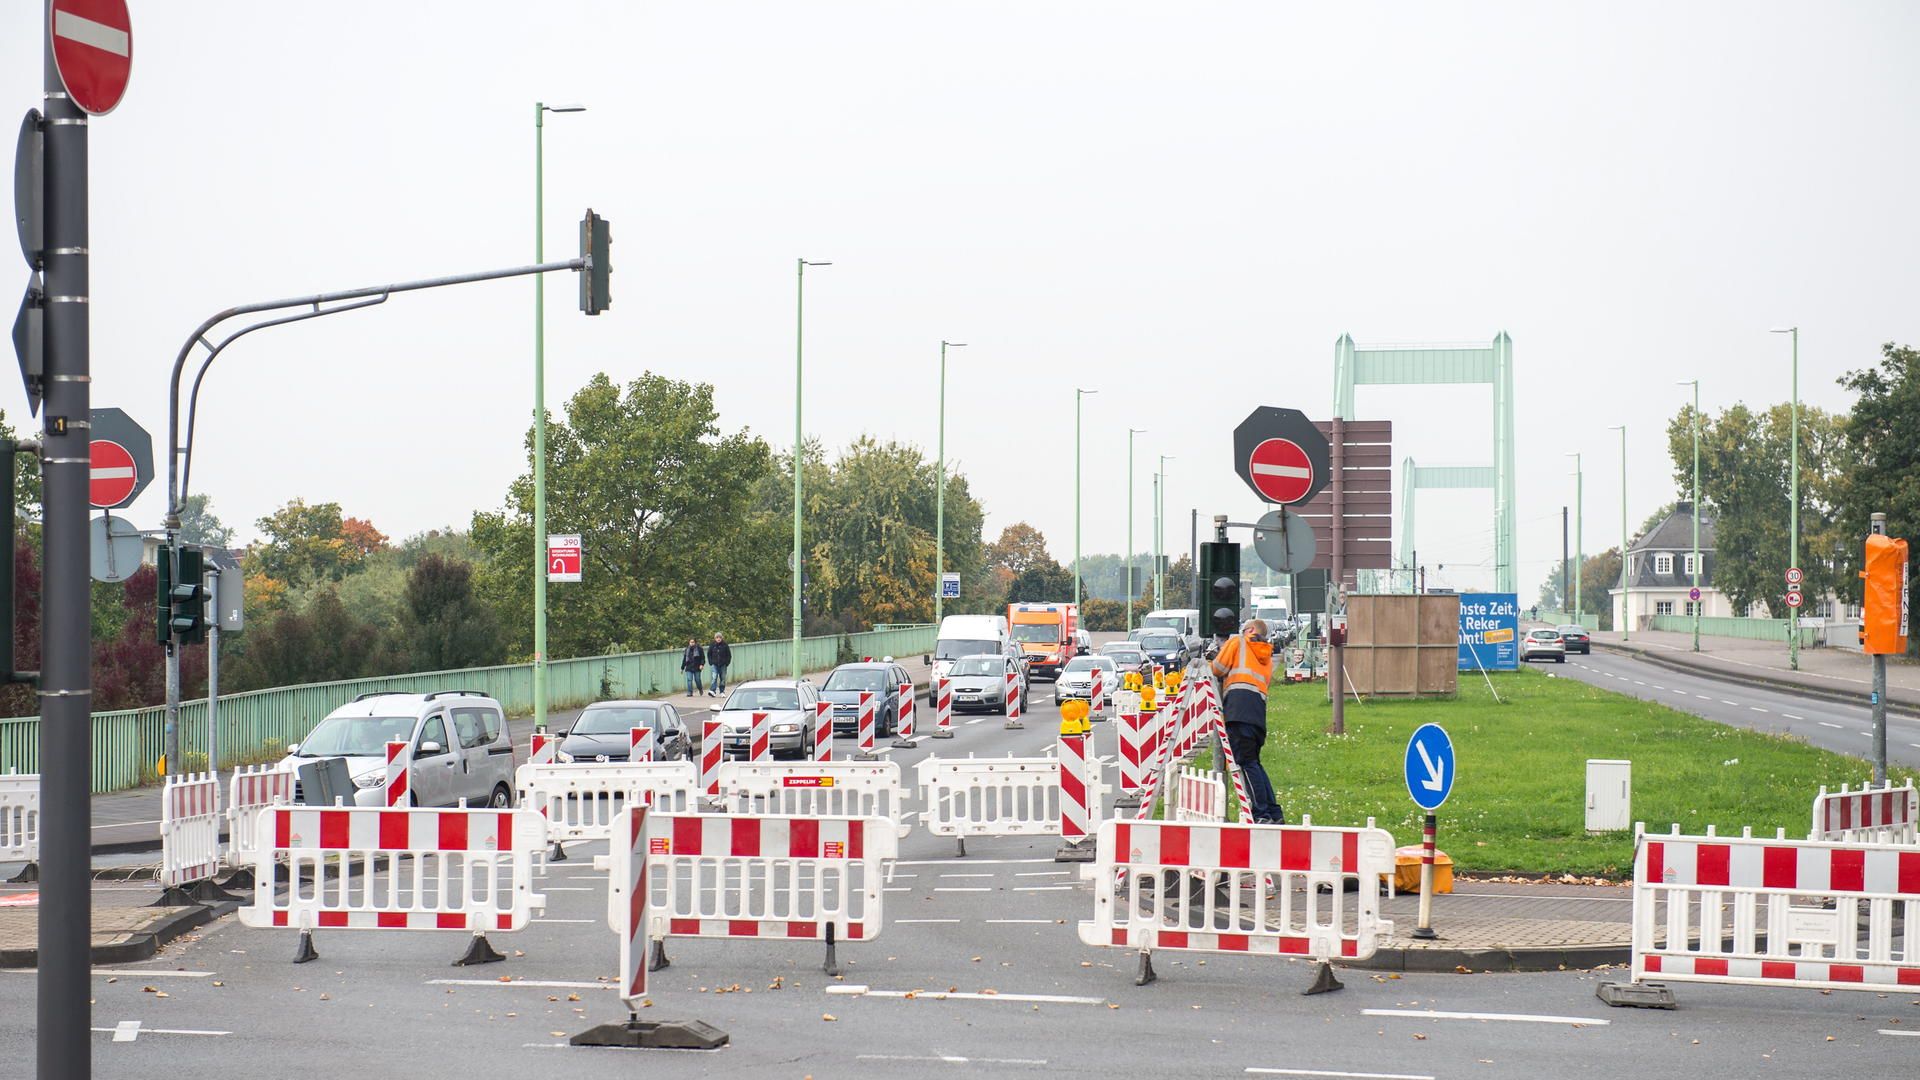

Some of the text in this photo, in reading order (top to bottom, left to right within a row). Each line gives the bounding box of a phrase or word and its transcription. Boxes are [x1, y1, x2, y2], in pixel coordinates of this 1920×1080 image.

[563, 538, 578, 546] 390
[1789, 572, 1799, 580] 30
[1489, 602, 1516, 617] Zeit,
[1465, 616, 1501, 630] Reker
